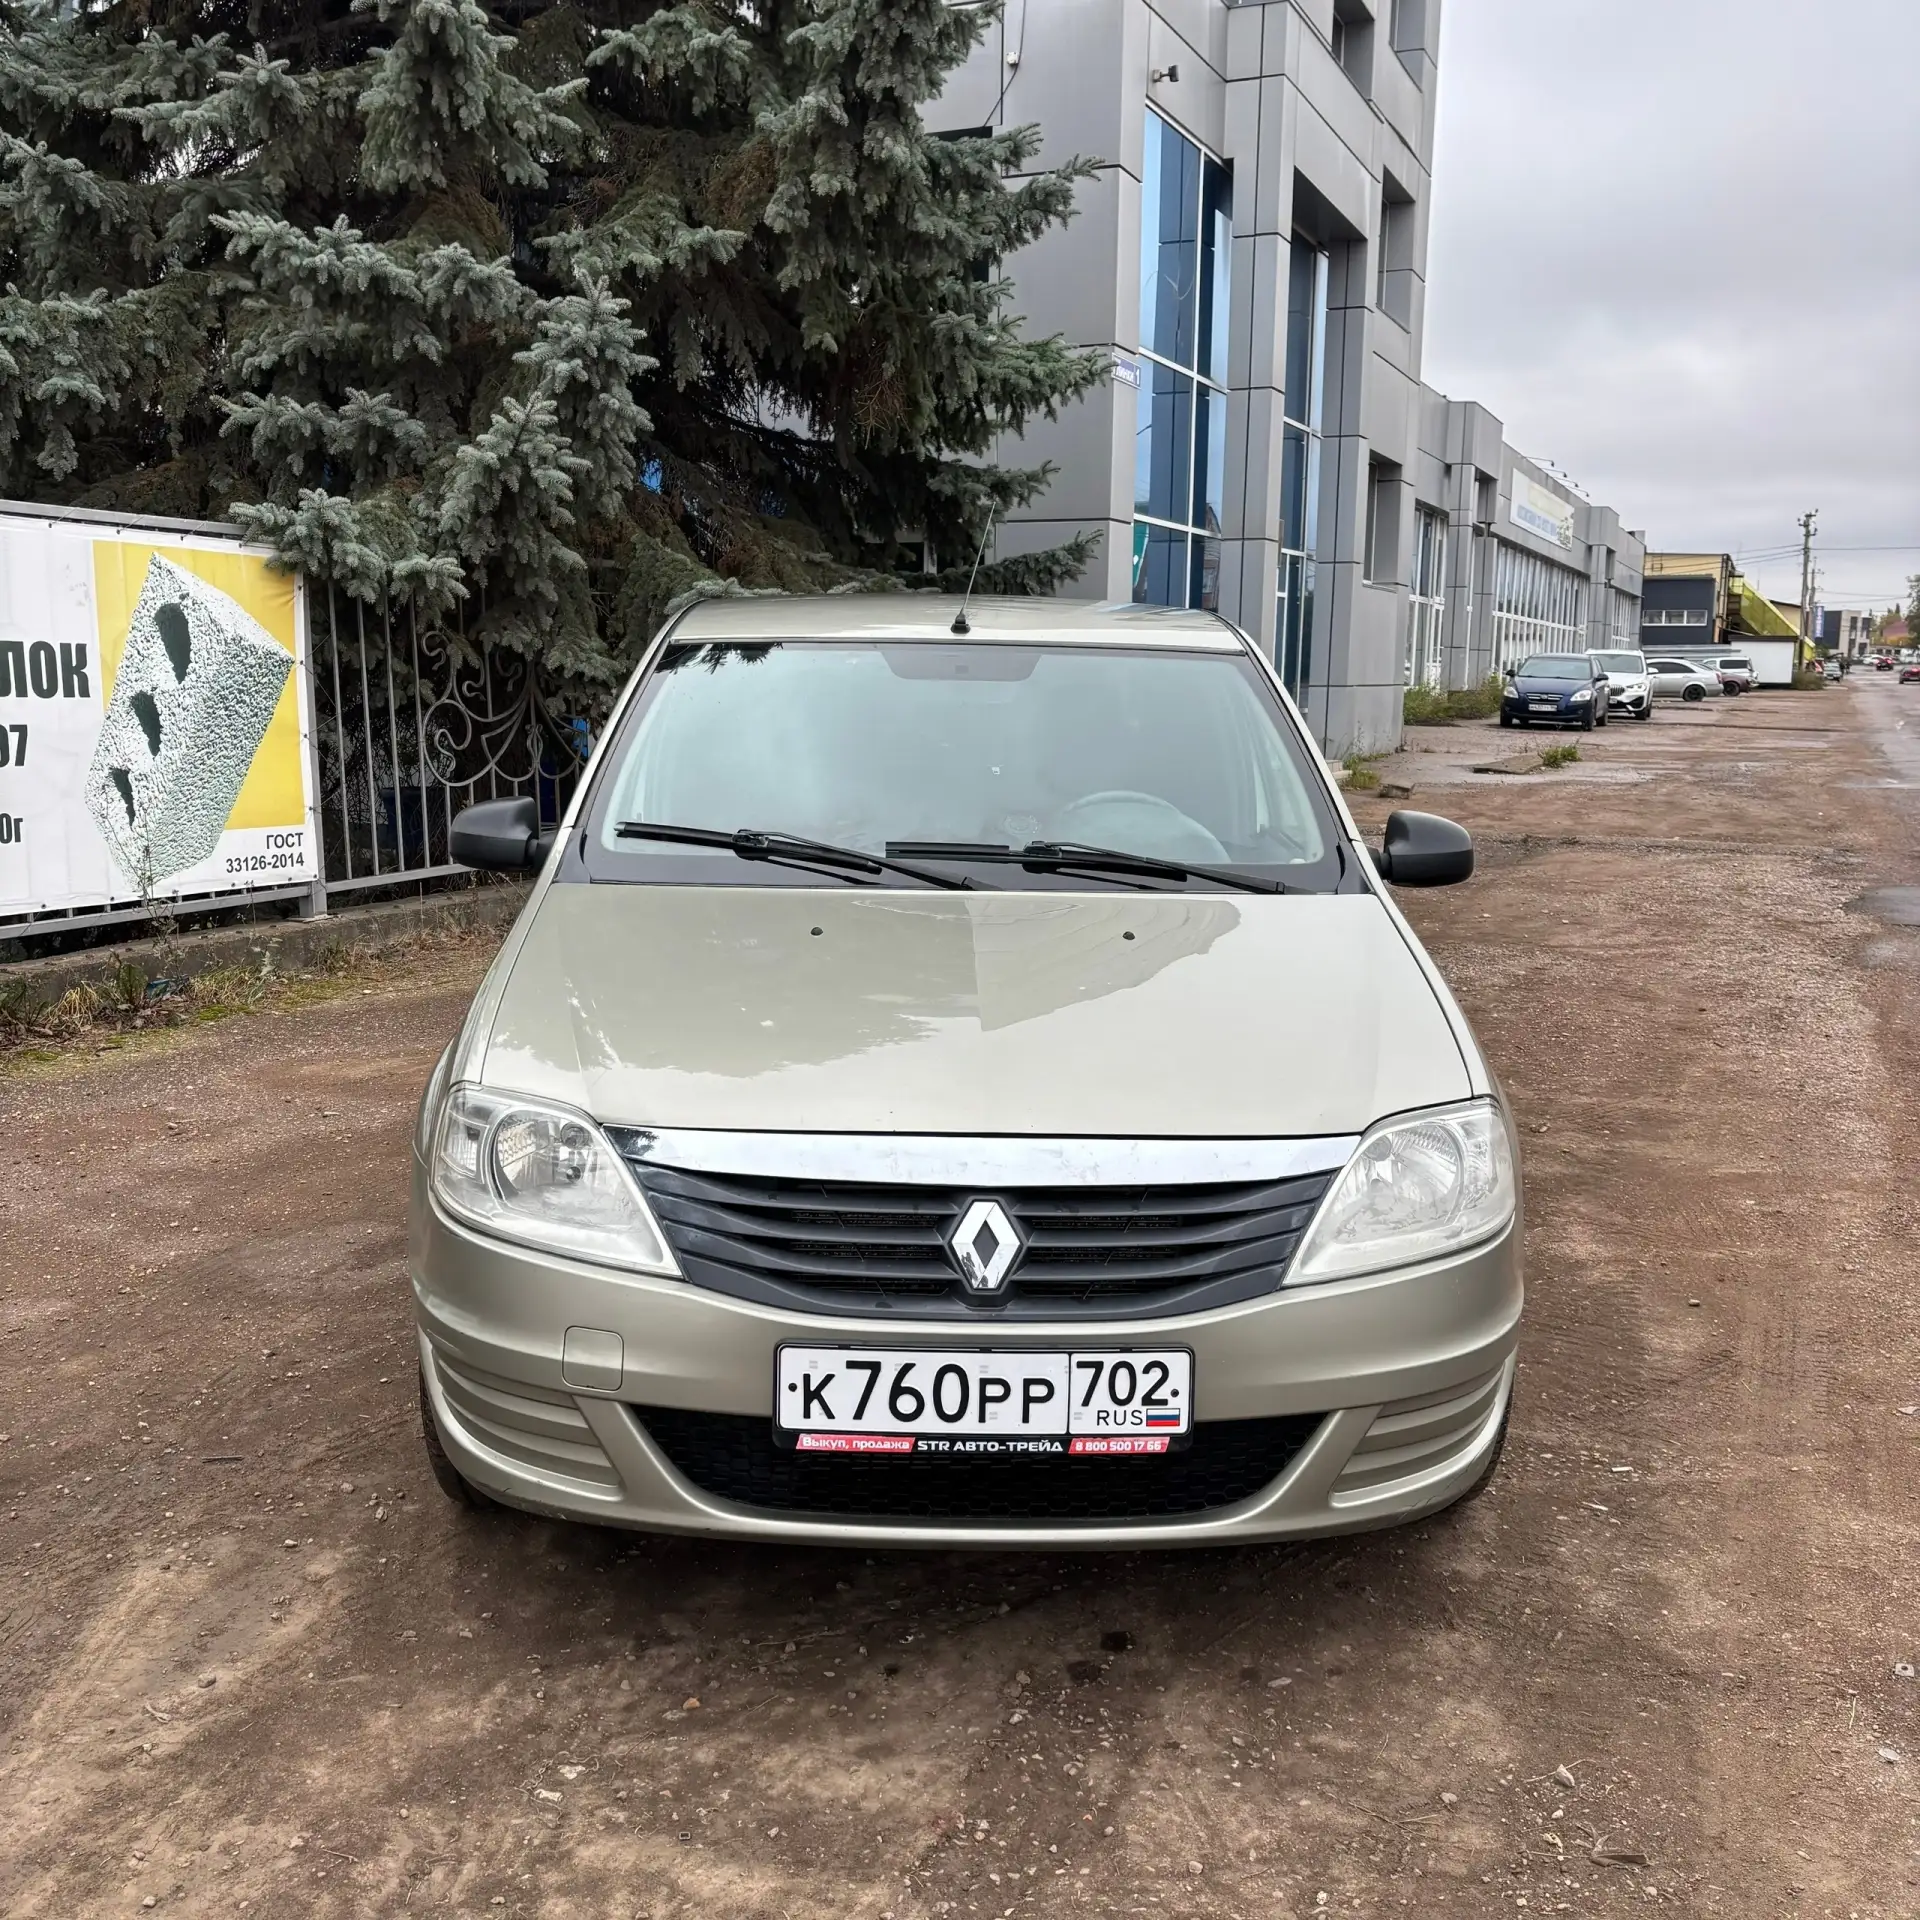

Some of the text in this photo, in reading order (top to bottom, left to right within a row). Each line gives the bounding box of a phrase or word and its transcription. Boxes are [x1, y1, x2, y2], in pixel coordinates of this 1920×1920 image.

[0, 641, 91, 698] ЛОК
[266, 832, 304, 849] ГОСТ
[226, 852, 305, 873] 33126-2014
[802, 1361, 1056, 1423] К760РР
[1076, 1360, 1171, 1407] 702
[1097, 1410, 1143, 1426] RUS
[803, 1437, 849, 1450] Выкуп,
[853, 1440, 910, 1451] продажа
[917, 1440, 950, 1451] STR
[953, 1439, 1063, 1452] АВТО-ТРЕЙД
[1075, 1441, 1083, 1451] 8
[1085, 1441, 1107, 1451] 800
[1109, 1441, 1131, 1451] 500
